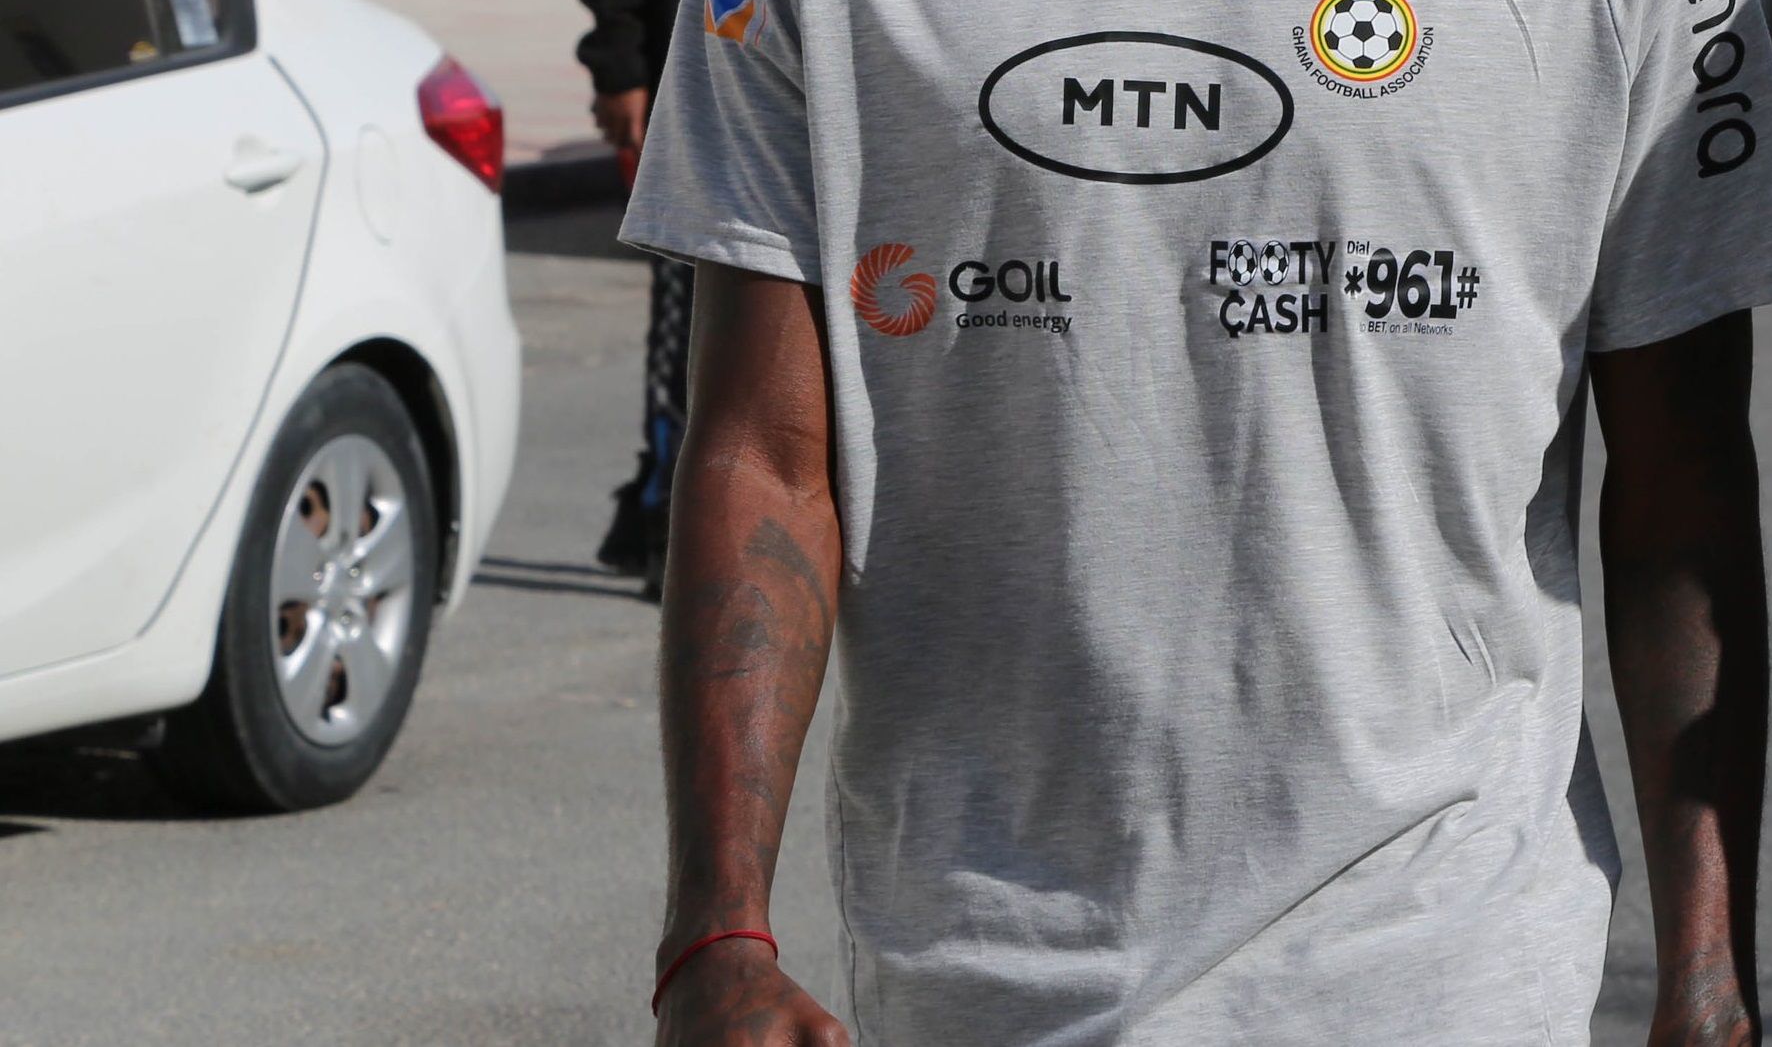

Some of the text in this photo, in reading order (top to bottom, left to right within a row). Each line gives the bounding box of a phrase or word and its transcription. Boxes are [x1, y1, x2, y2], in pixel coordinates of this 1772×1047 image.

[1292, 25, 1434, 99] GHANA FOOTBALL ASSOCIATION
[1062, 77, 1222, 131] MTN
[1209, 239, 1336, 287] FOOTY
[1347, 240, 1370, 255] Dial
[948, 259, 1073, 303] GOIL
[955, 310, 1073, 334] Good energy
[1414, 323, 1453, 336] Networks
